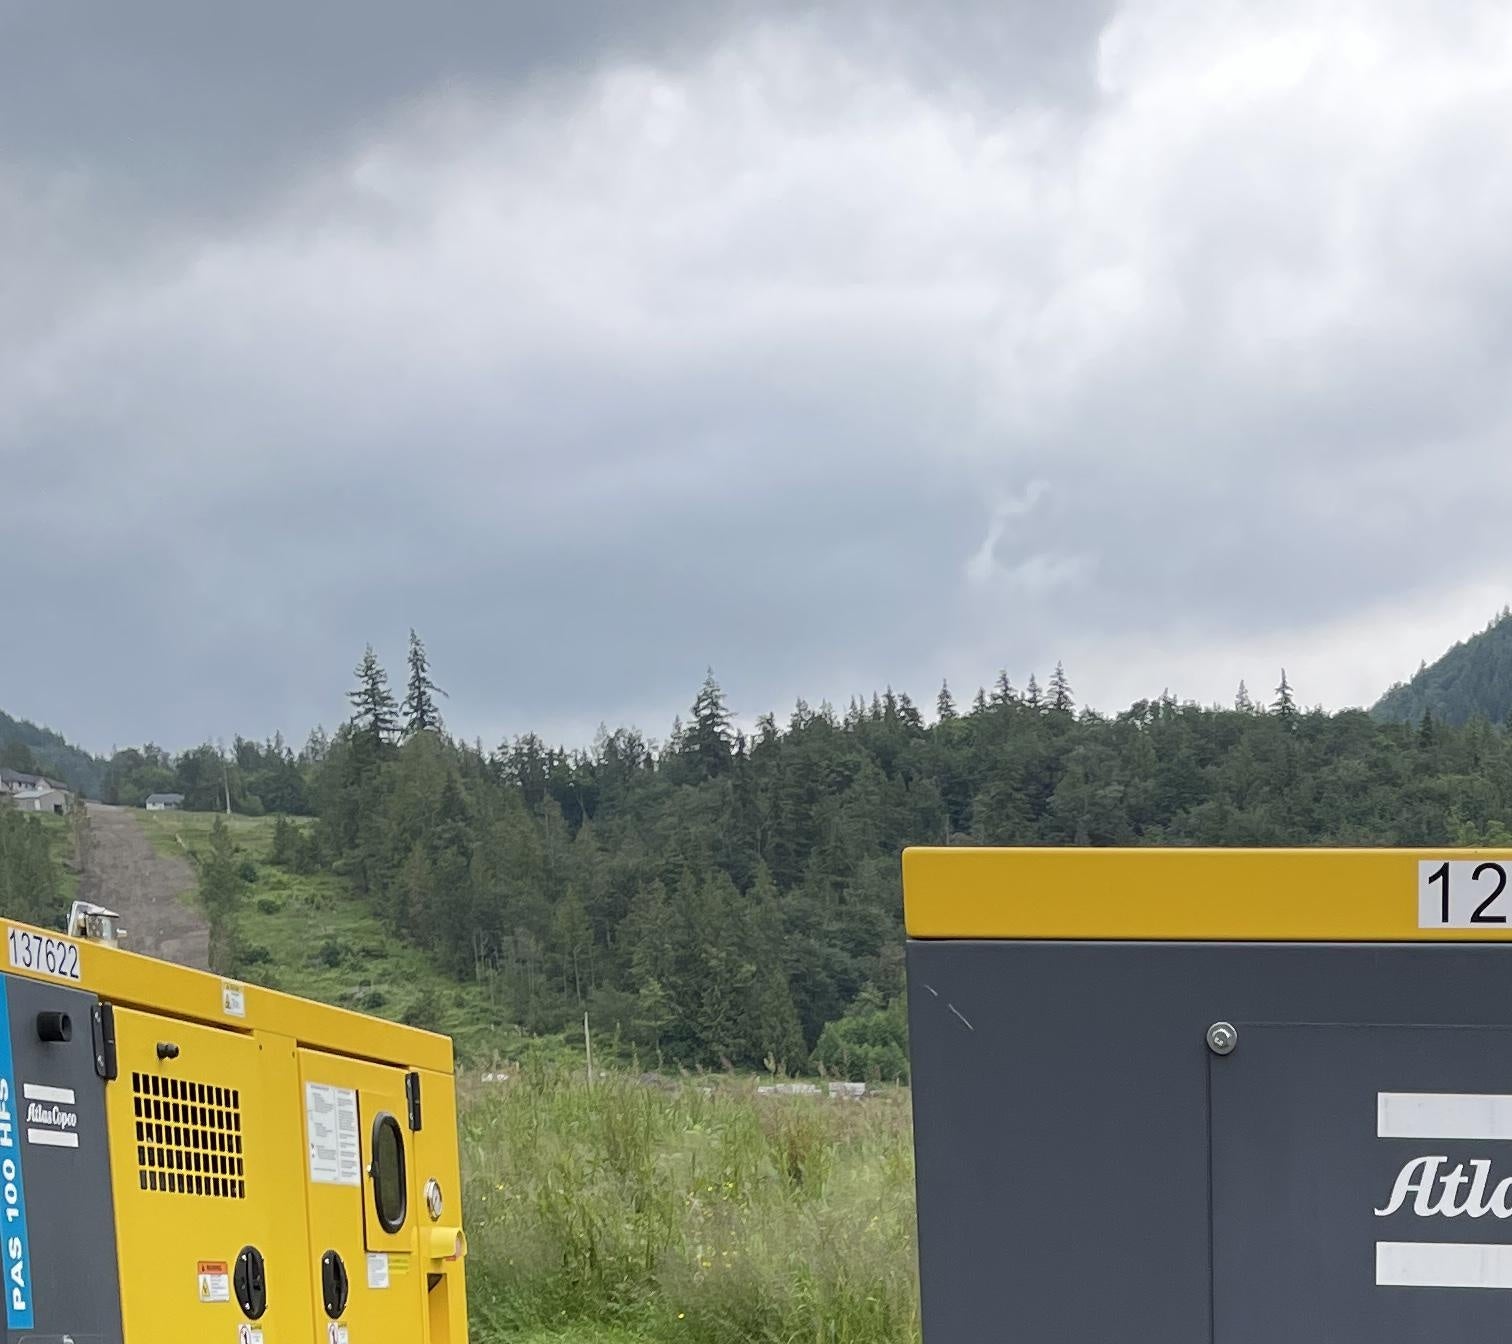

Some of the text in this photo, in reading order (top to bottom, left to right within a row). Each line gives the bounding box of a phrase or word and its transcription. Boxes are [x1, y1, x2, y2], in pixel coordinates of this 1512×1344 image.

[9, 928, 79, 979] 137622
[26, 1102, 77, 1130] Atlas Copco
[2, 1158, 20, 1223] 100
[8, 1236, 26, 1311] PAS
